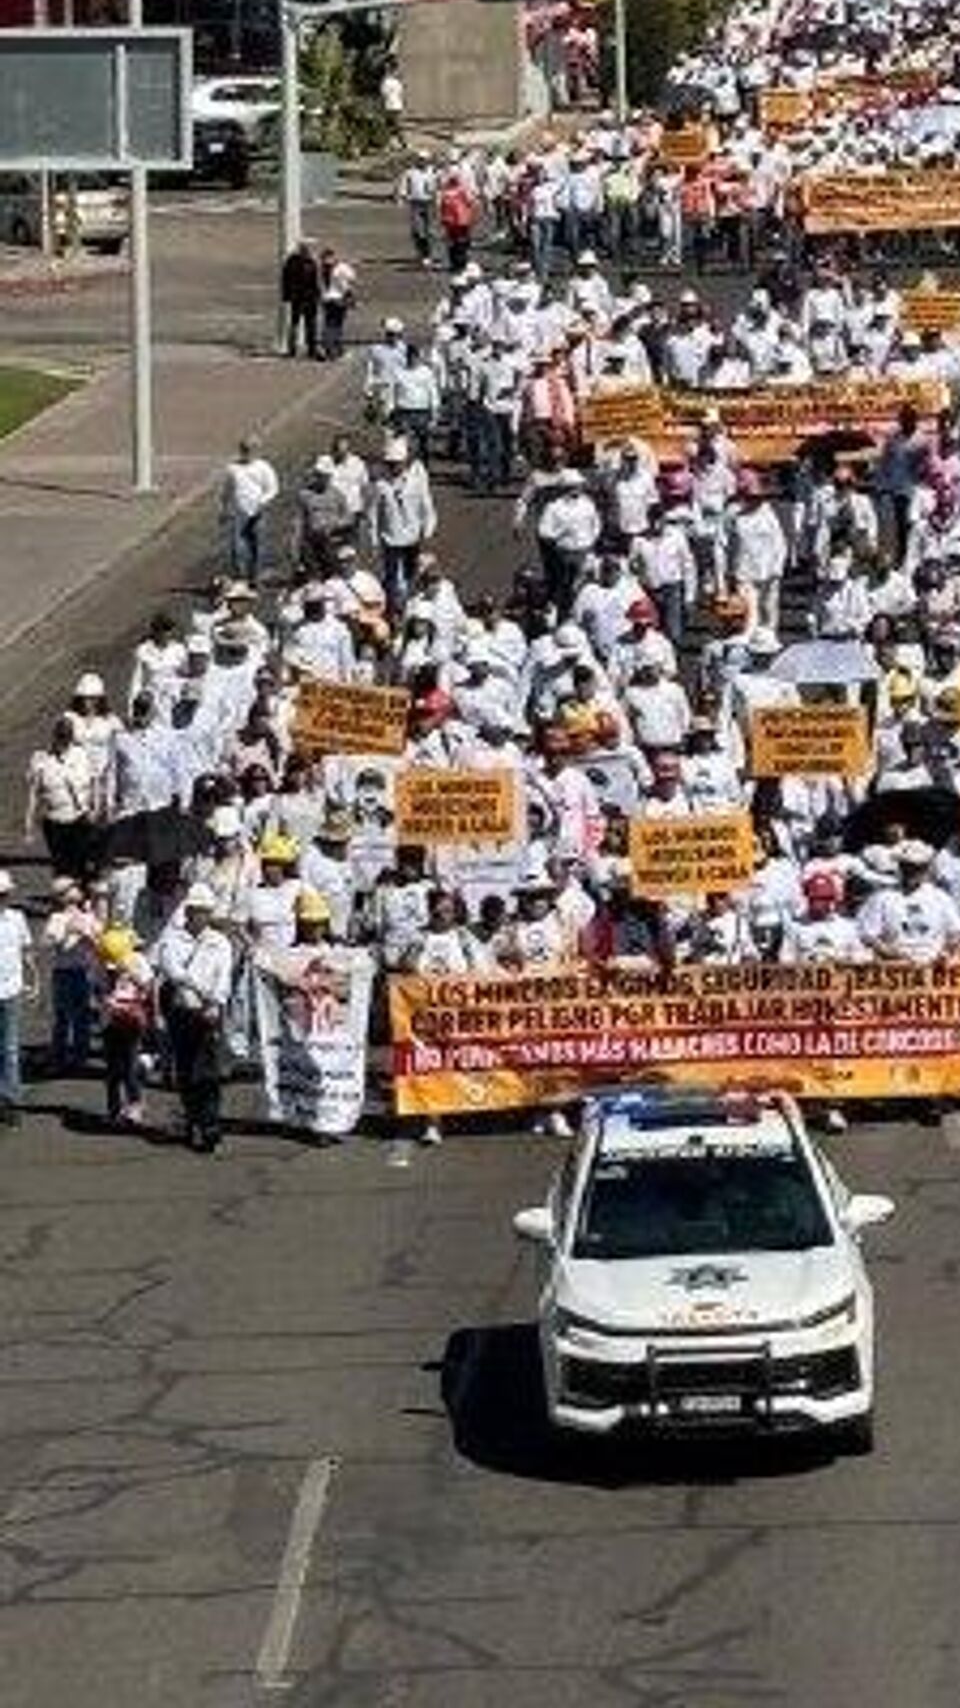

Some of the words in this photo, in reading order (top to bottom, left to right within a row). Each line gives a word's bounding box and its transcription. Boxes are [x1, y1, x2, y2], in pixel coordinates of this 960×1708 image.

[426, 982, 467, 1008] LOS
[474, 977, 578, 1004] MINEROS
[932, 960, 960, 988] DE
[411, 1009, 500, 1038] CORRER
[508, 1004, 602, 1032] PELIGRO
[610, 1002, 656, 1029] POR
[663, 997, 788, 1025] TRABAJAR
[743, 1032, 801, 1055] COMO
[804, 1032, 832, 1055] LA
[834, 1031, 861, 1055] DE
